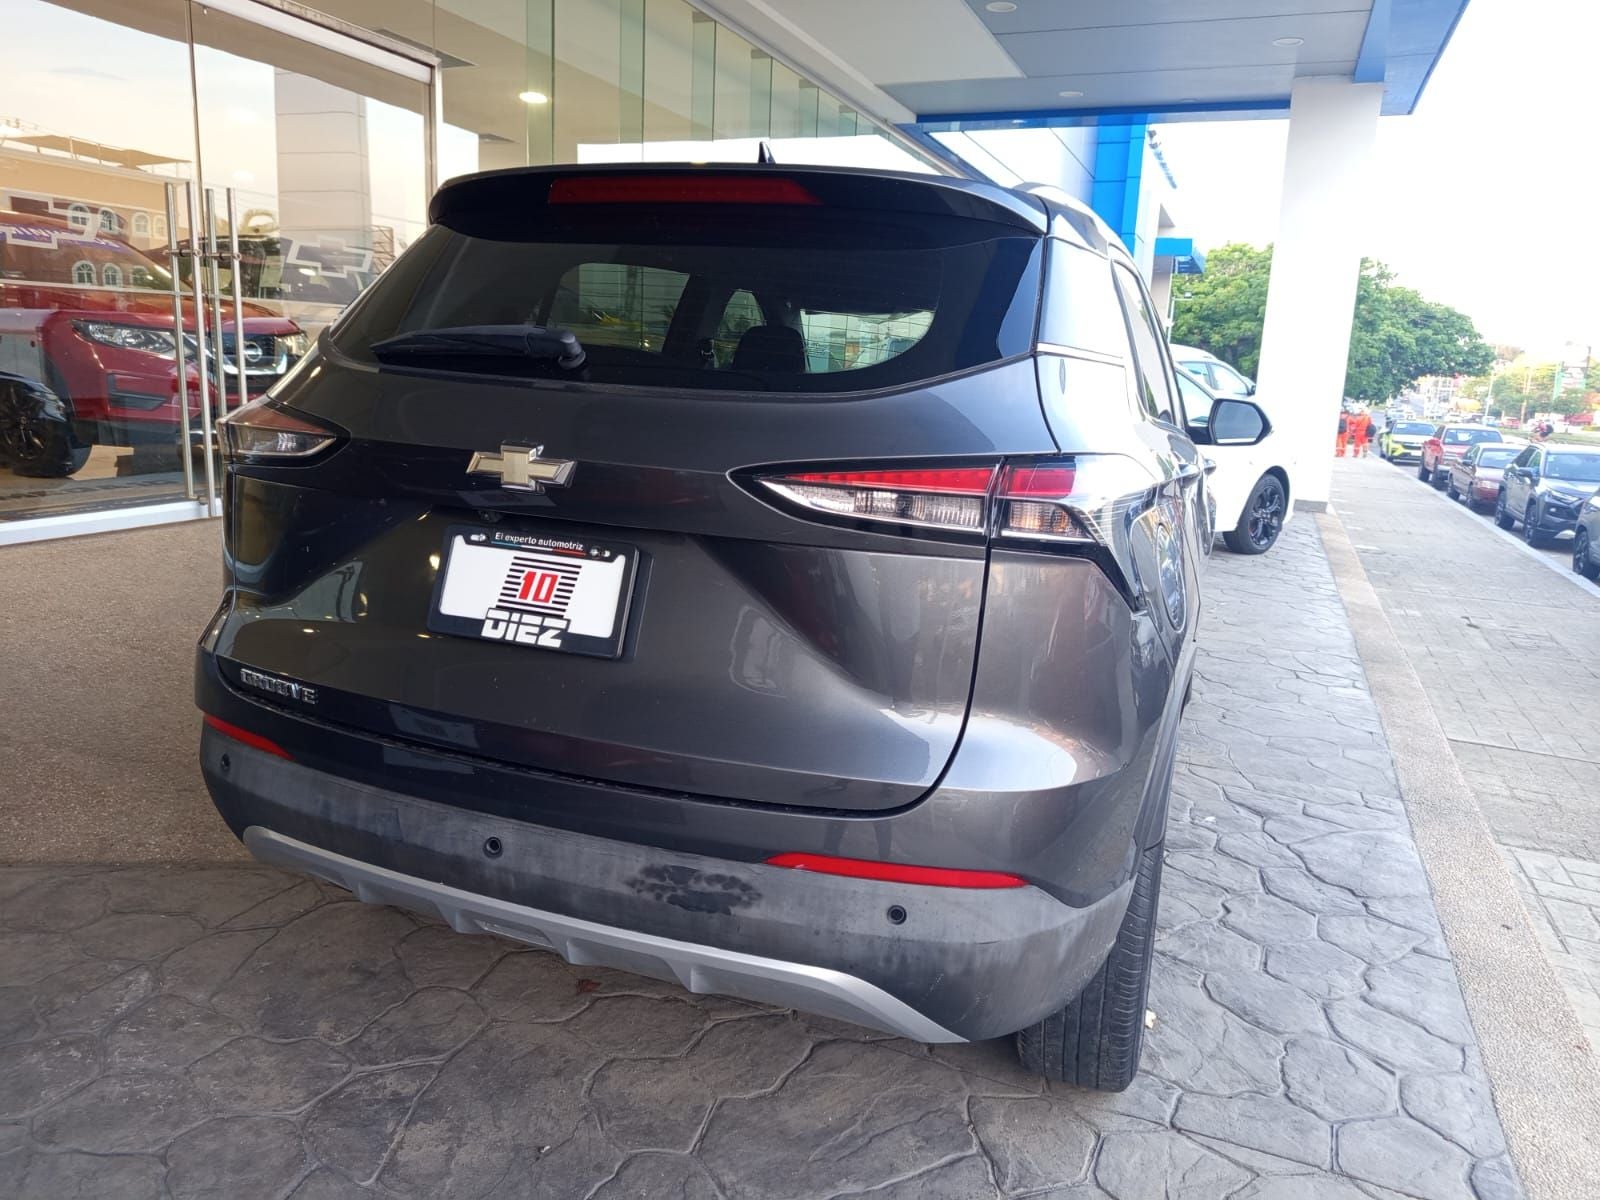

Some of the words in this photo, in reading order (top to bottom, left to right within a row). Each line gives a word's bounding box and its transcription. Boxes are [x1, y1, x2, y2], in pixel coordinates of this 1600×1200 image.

[495, 531, 504, 540] El
[504, 535, 537, 545] experto
[538, 540, 584, 551] automotriz
[518, 571, 558, 603] 10
[481, 609, 568, 648] DIEZ
